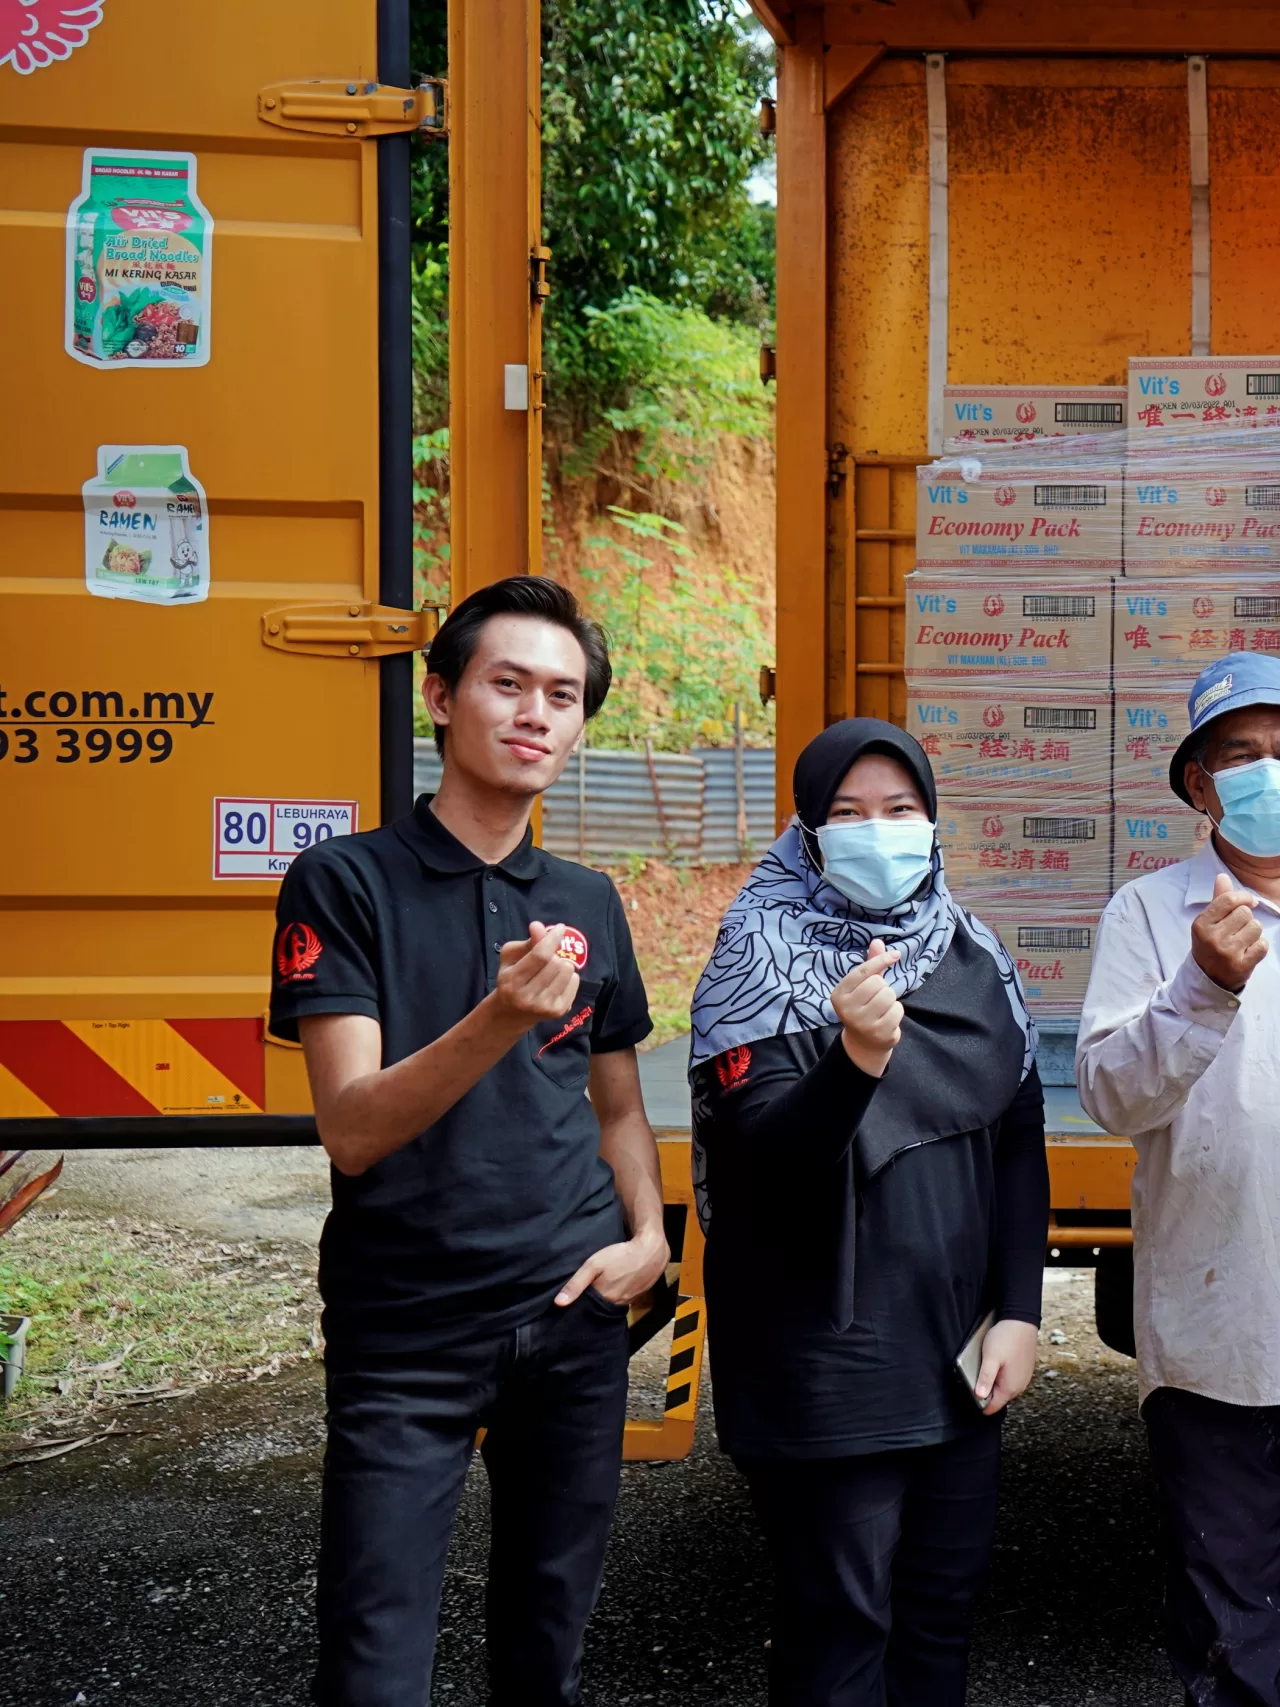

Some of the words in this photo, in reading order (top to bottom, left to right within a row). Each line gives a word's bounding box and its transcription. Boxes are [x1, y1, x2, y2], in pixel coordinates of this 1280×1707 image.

[120, 207, 182, 220] Vit's
[105, 236, 128, 247] Air
[131, 237, 168, 250] Dried
[105, 248, 146, 260] Broad
[149, 250, 199, 264] Noodles
[105, 268, 118, 278] MI
[122, 269, 161, 280] KERING
[165, 270, 196, 280] KASAR
[1138, 376, 1180, 396] Vit's
[954, 403, 992, 421] Vit's
[1180, 401, 1220, 410] 20/03/2022
[992, 428, 1029, 436] 20/03/2022
[928, 486, 968, 504] Vit's
[1136, 486, 1178, 505] Vit's
[166, 503, 195, 514] RAME
[100, 510, 157, 532] RAMEN
[928, 516, 1024, 542] Economy
[1029, 517, 1081, 537] Pack
[1136, 517, 1235, 542] Economy
[959, 545, 970, 555] VIT
[972, 545, 1006, 555] MAKANAN
[135, 577, 147, 585] LOW
[916, 594, 957, 614] Vit's
[1126, 596, 1168, 616] Vit's
[916, 626, 1013, 652] Economy
[1017, 628, 1070, 648] Pack
[948, 655, 958, 664] VIT
[960, 655, 994, 665] MAKANAN
[917, 704, 959, 725] Vit's
[1126, 708, 1168, 728] Vit's
[56, 728, 173, 764] 3999
[276, 808, 348, 819] LEBUHRAYA
[223, 811, 267, 844] 80
[293, 822, 333, 849] 90
[1126, 819, 1168, 838] Vit's
[561, 936, 584, 954] it's
[1016, 959, 1065, 979] Pack
